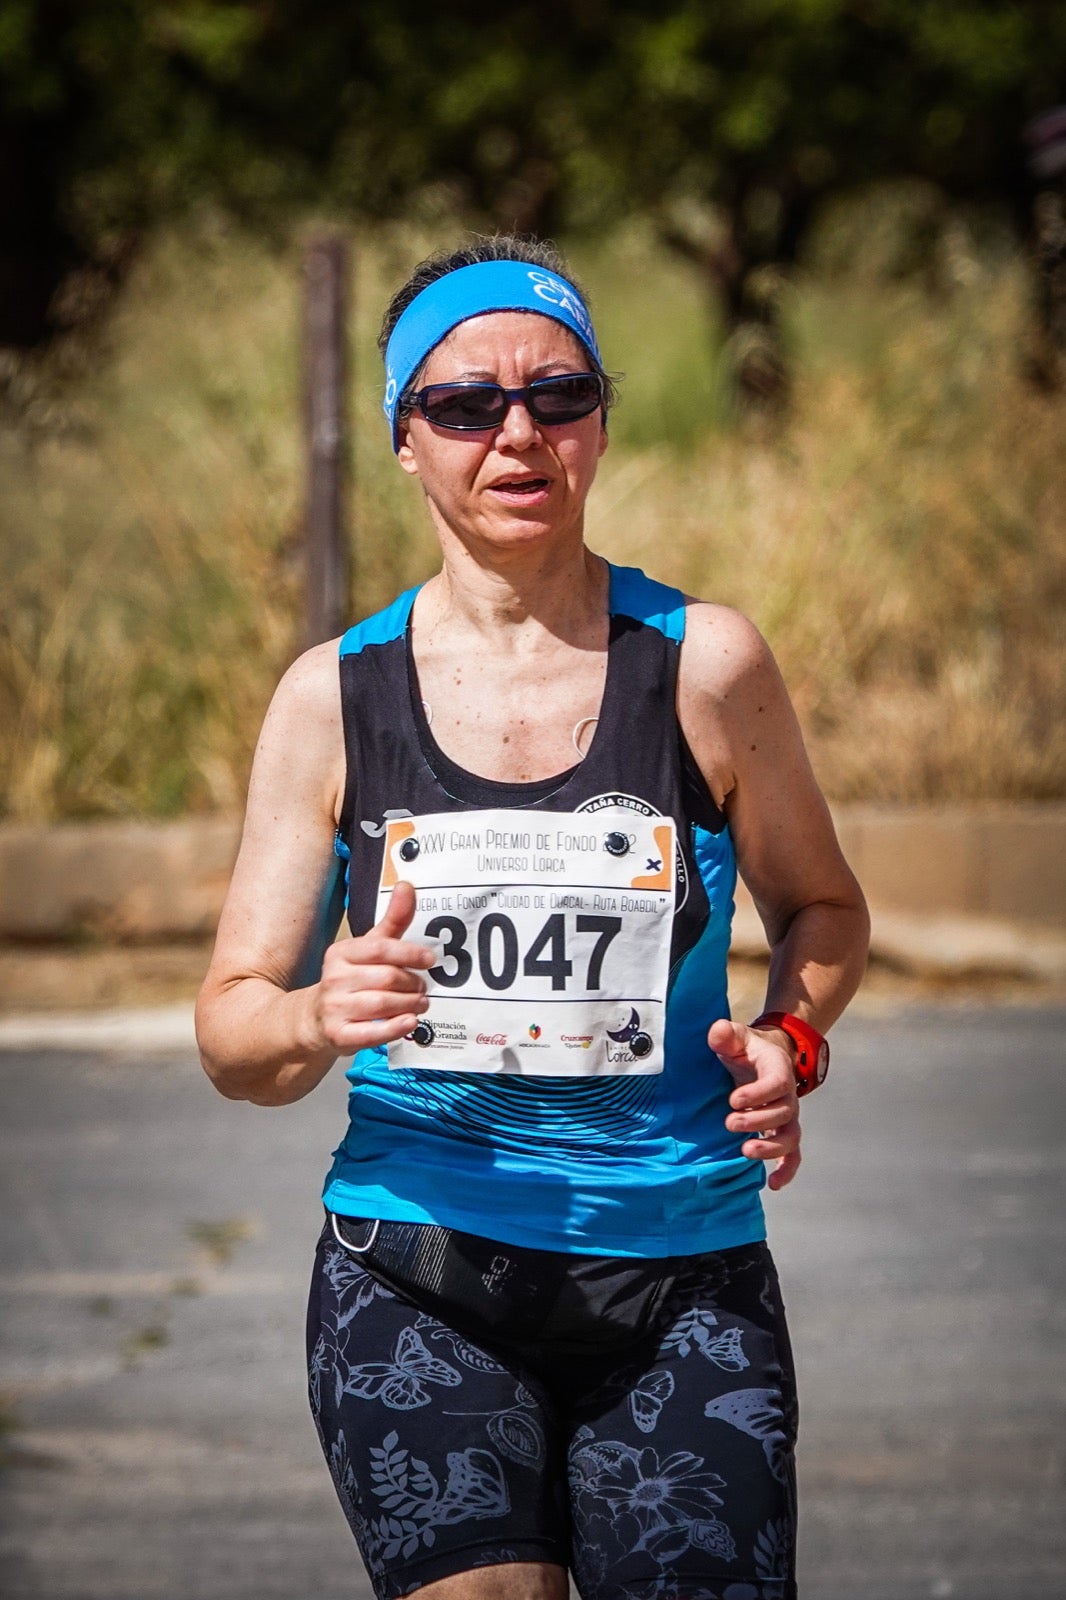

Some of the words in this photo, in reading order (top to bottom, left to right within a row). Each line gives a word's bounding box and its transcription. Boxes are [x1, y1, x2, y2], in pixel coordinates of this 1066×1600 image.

[582, 798, 615, 813] TAÑA
[617, 798, 650, 815] CERRO
[450, 831, 480, 851] GRAN
[486, 829, 531, 850] PREMIO
[536, 833, 551, 850] DE
[556, 831, 597, 852] FONDO
[477, 854, 528, 873] UNIVERSO
[533, 854, 566, 873] LORCA
[441, 896, 453, 911] DE
[457, 893, 488, 910] FONDO
[534, 895, 546, 909] DE
[593, 894, 617, 911] RUTA
[424, 912, 622, 991] 3047
